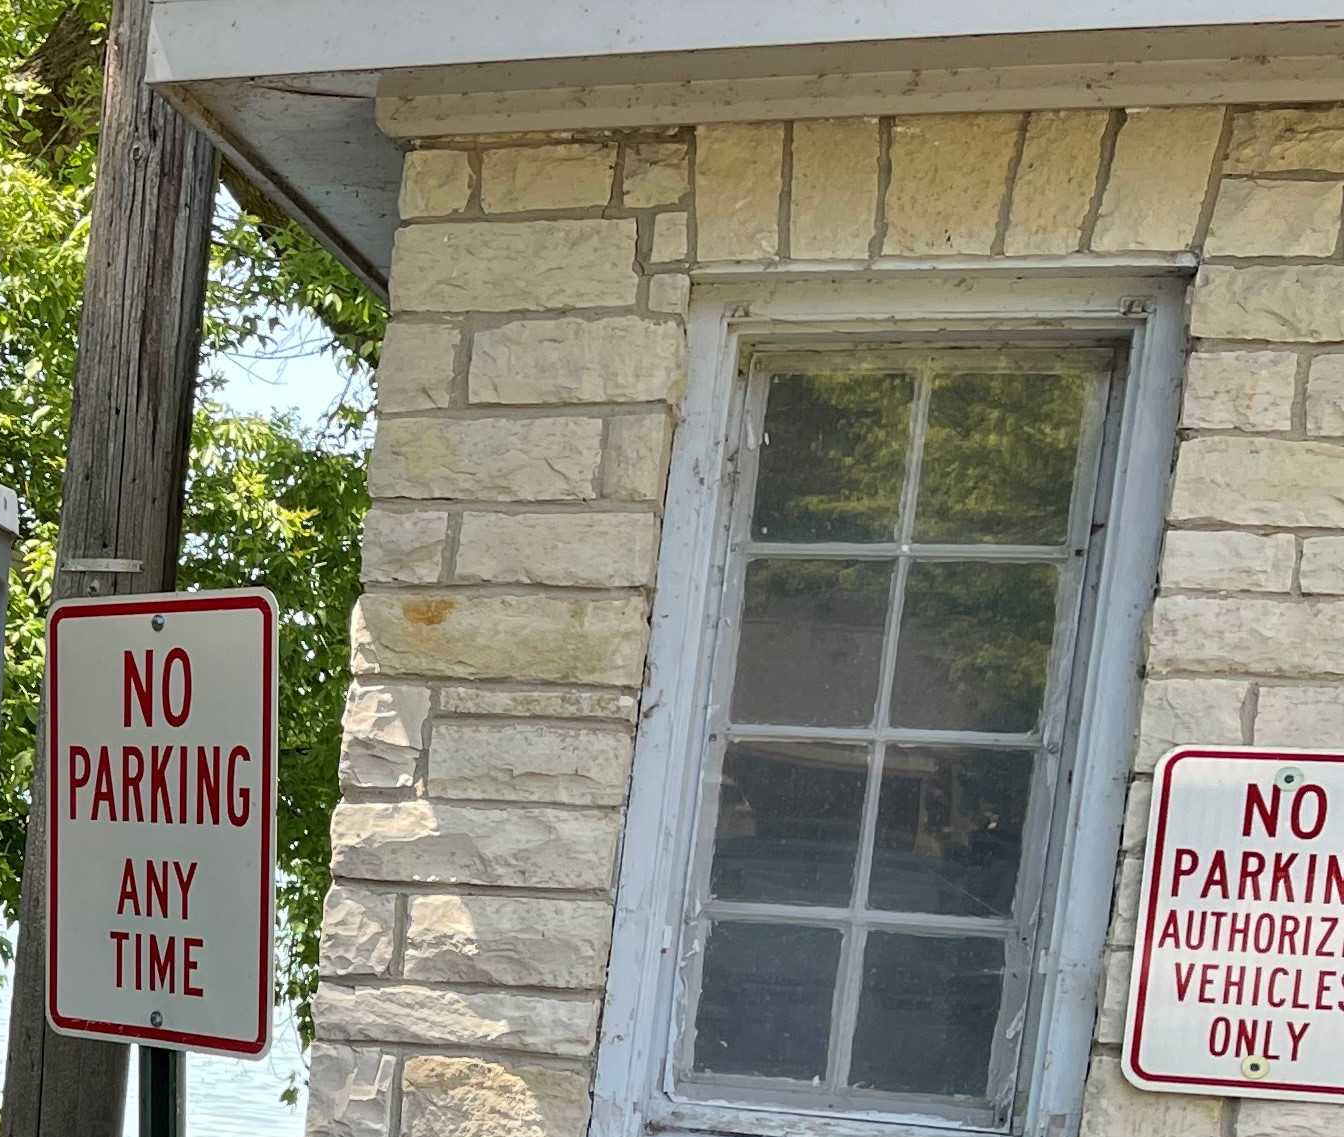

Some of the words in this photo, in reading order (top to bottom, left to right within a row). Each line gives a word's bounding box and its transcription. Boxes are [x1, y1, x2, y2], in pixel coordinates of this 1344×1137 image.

[123, 647, 193, 728] NO
[69, 745, 252, 828] PARKING
[1242, 783, 1328, 840] NO
[116, 857, 198, 921] ANY
[110, 931, 205, 998] TIME
[1158, 909, 1344, 958] AUTHORIZ
[1208, 1016, 1311, 1062] ONLY
